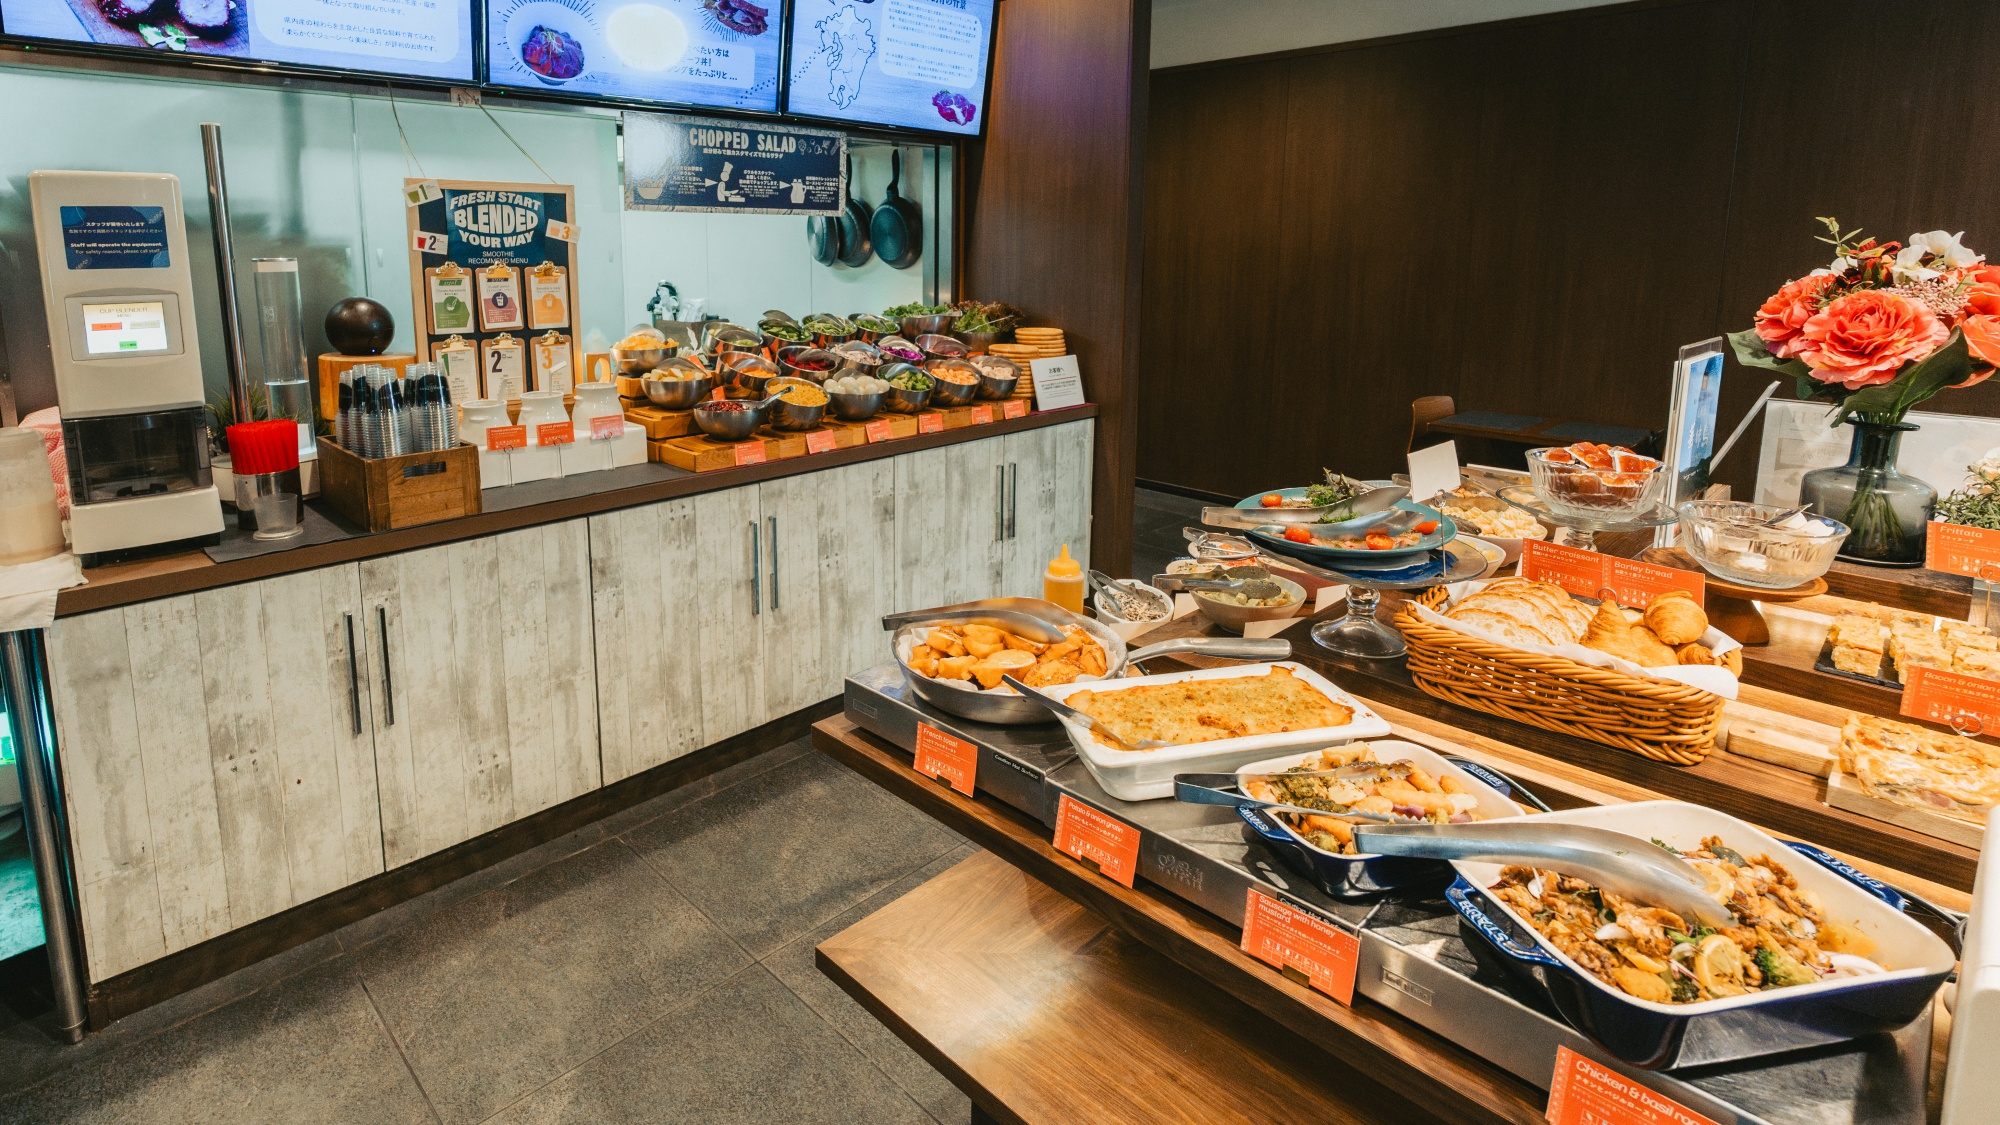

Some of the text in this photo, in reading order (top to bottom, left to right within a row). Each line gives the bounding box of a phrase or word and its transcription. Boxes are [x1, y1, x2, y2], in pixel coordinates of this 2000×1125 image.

[689, 127, 797, 153] CHOPPED SALAD
[418, 184, 428, 200] 1
[450, 191, 541, 211] FRESH START
[453, 204, 539, 235] BLENDED
[428, 235, 437, 251] 2
[458, 229, 535, 248] YOUR WAY
[561, 225, 571, 240] 3
[468, 257, 509, 265] RECOMMEND
[482, 250, 514, 258] SMOOTHIE
[490, 350, 503, 373] 2
[541, 347, 553, 369] 3
[1940, 525, 1983, 538] Frittata
[1532, 543, 1600, 564] Butter croissant
[1614, 560, 1673, 579] Barley bread
[1924, 671, 1957, 684] Bacon
[1966, 681, 1996, 692] onion
[923, 727, 958, 749] French toast
[994, 754, 1039, 780] Caution Hot Surface
[1468, 763, 1504, 786] STAUB
[1068, 801, 1086, 815] Potato
[1090, 813, 1106, 826] onion
[1105, 820, 1124, 834] gratin
[1258, 903, 1291, 924] mustard
[1259, 895, 1292, 917] Sausage
[1293, 912, 1310, 925] with
[1310, 919, 1336, 938] honey
[1457, 899, 1510, 943] STAUB
[1575, 1059, 1628, 1094] Chicken
[1627, 1084, 1641, 1099] &
[1640, 1091, 1674, 1117] basil
